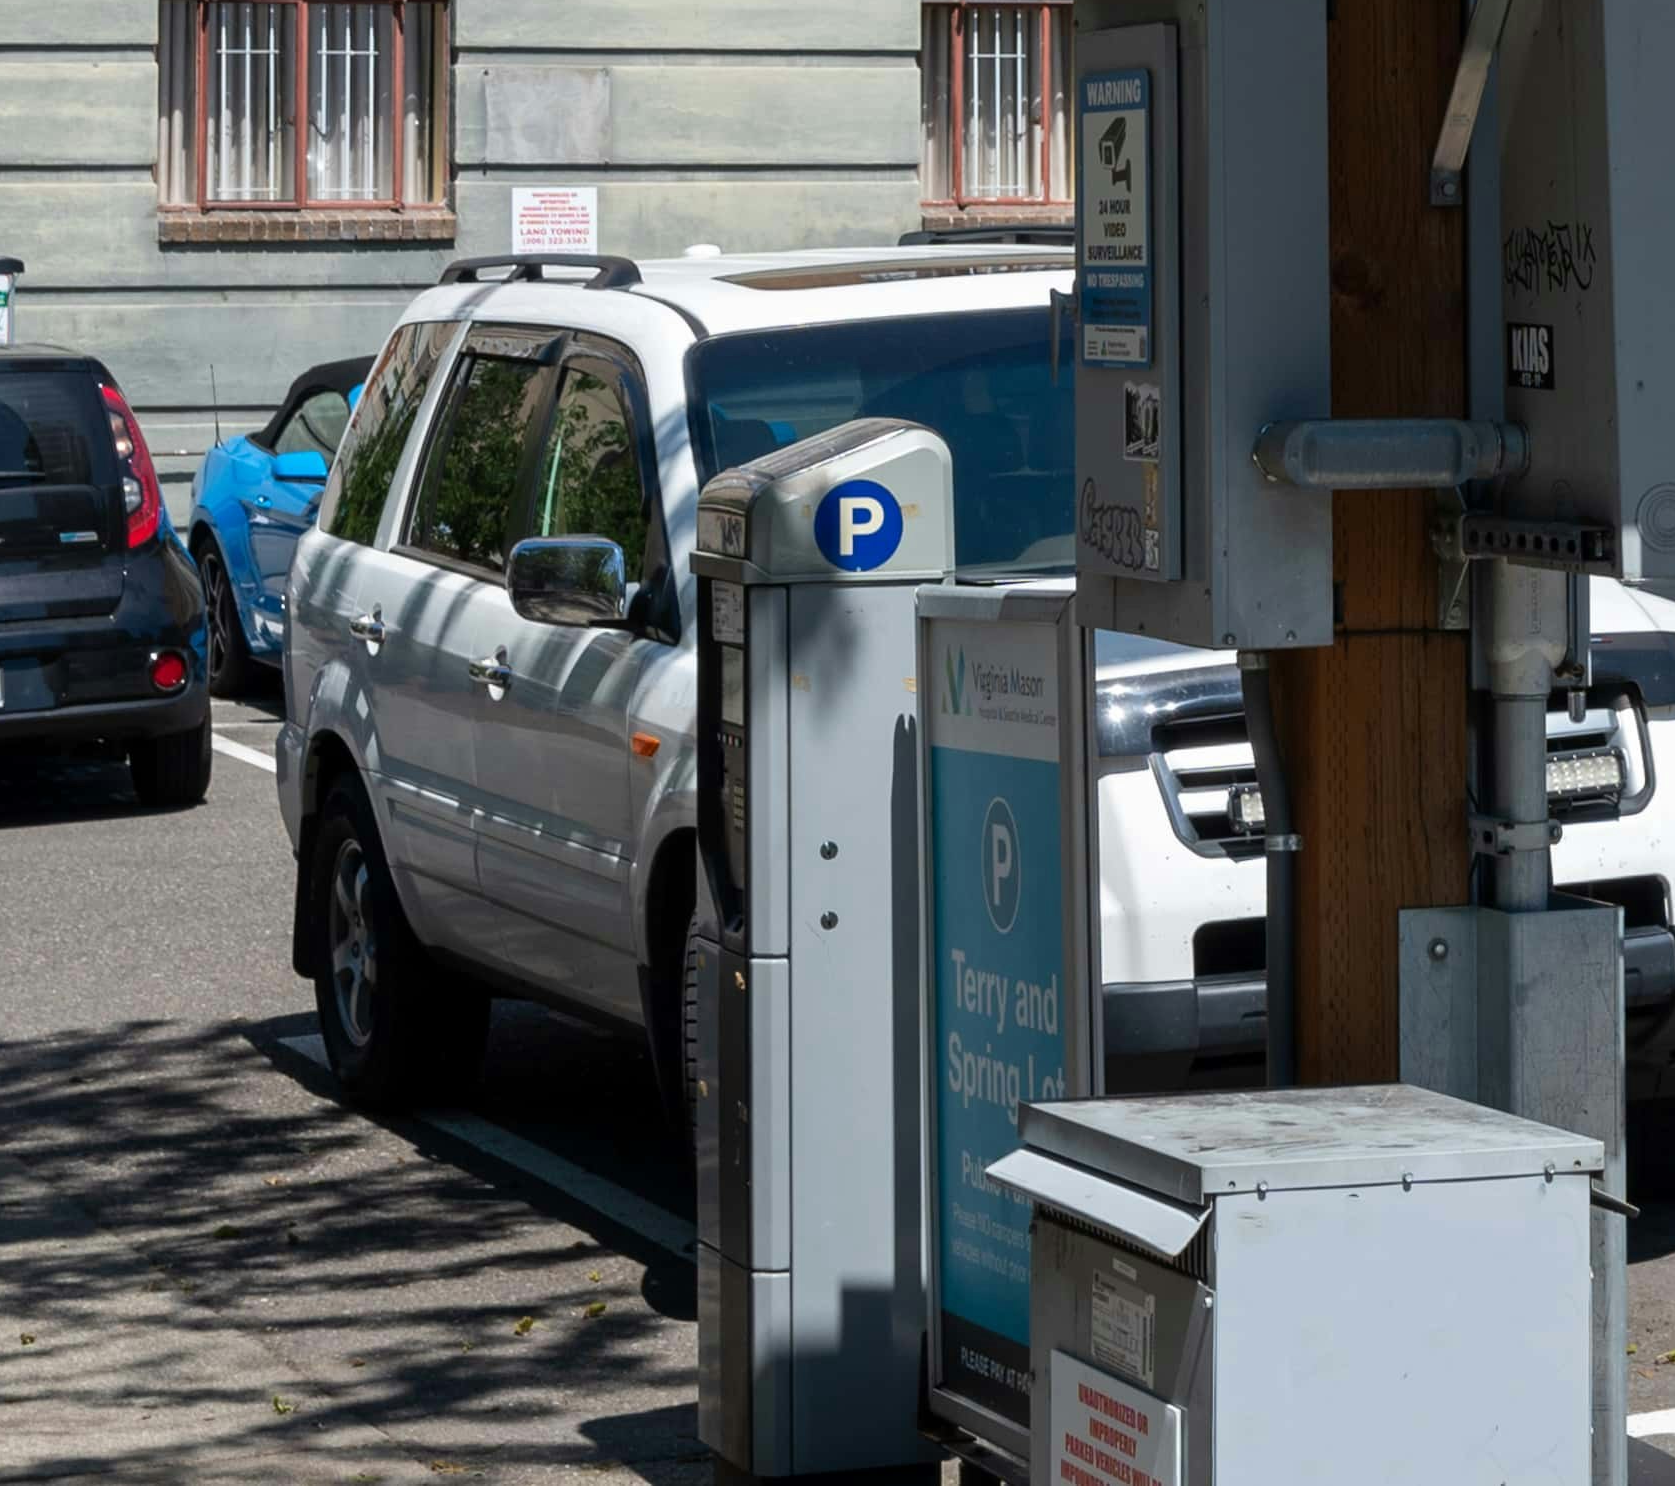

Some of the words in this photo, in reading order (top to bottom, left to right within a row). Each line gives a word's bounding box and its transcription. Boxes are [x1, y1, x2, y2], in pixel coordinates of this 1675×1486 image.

[1086, 79, 1141, 106] WARNING
[1098, 199, 1108, 215] 24
[1109, 198, 1131, 214] HOUR
[1103, 221, 1127, 238] VIDEO
[1087, 244, 1143, 261] SURVEILLANCE
[1511, 327, 1549, 375] KIAS
[839, 496, 885, 557] P
[972, 660, 1008, 700] Virginia
[1010, 667, 1044, 698] Mason
[992, 823, 1013, 906] P
[951, 948, 1008, 1034] Terry
[1015, 974, 1058, 1035] and
[948, 1031, 1020, 1125] Spring
[960, 1346, 990, 1376] PLEASE
[1078, 1383, 1136, 1429] UNAUTHORIZED
[1137, 1411, 1149, 1436] OR
[1065, 1433, 1094, 1465] PARKED
[1095, 1449, 1131, 1484] VEHICLES
[1089, 1417, 1137, 1459] IMPROPERLY
